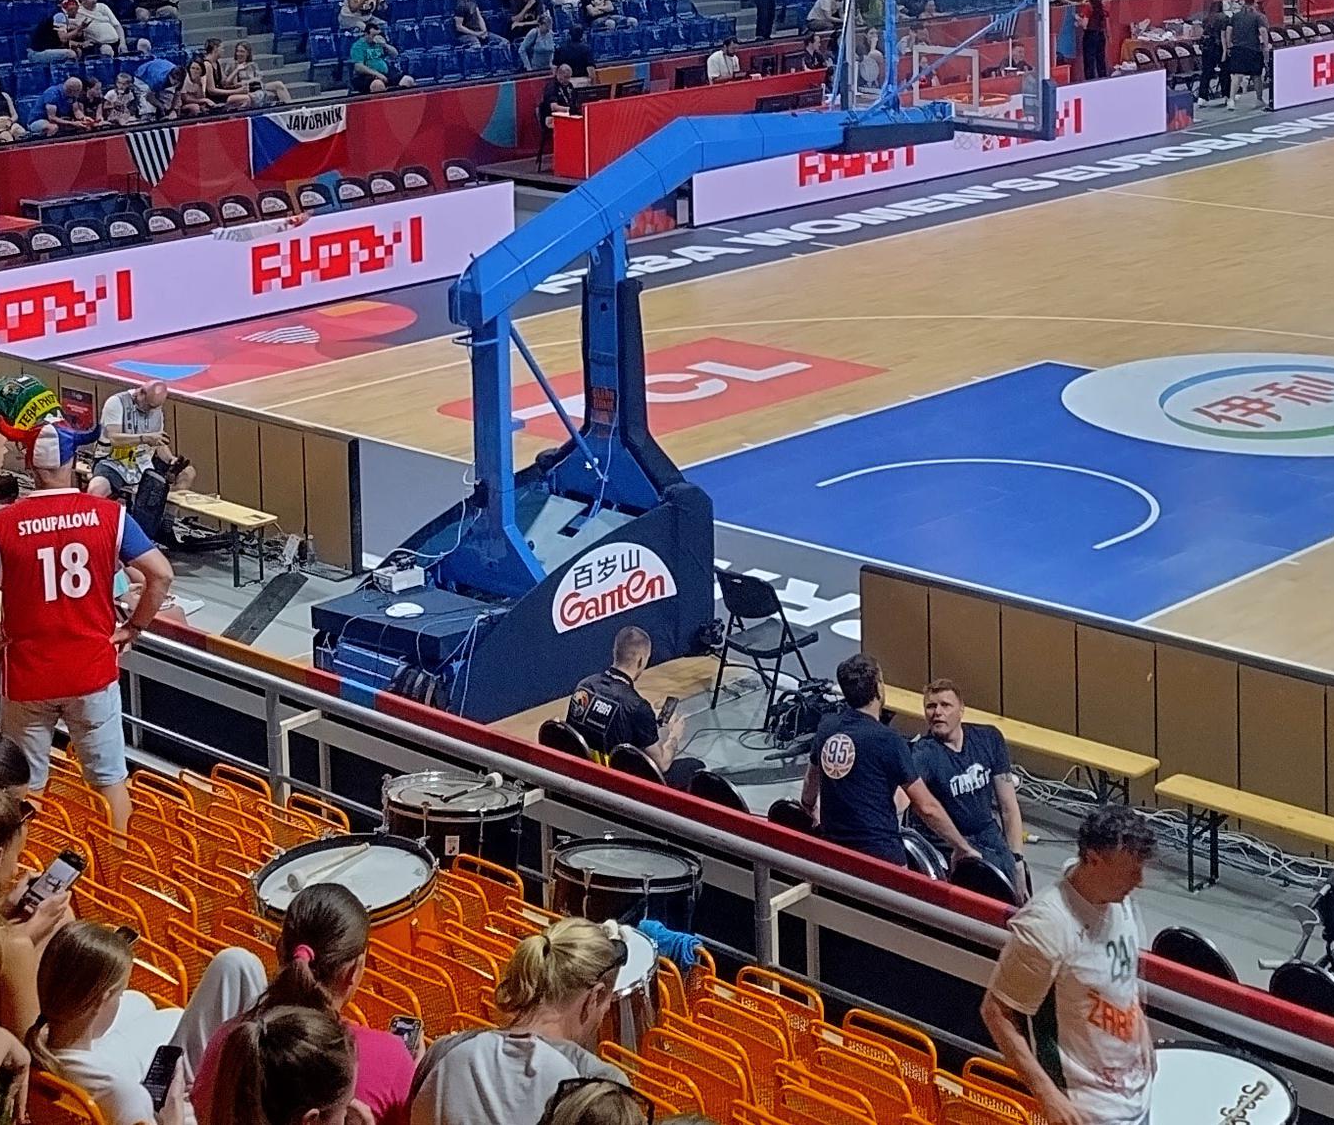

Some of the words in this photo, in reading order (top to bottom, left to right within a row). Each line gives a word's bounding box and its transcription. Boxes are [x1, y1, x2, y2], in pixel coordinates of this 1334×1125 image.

[722, 175, 1060, 247] WOMEN'S
[18, 401, 41, 427] TEAM
[17, 508, 100, 537] STOUPALOVÁ
[36, 542, 92, 603] 18
[573, 548, 641, 591] 百岁山
[827, 738, 849, 764] 95
